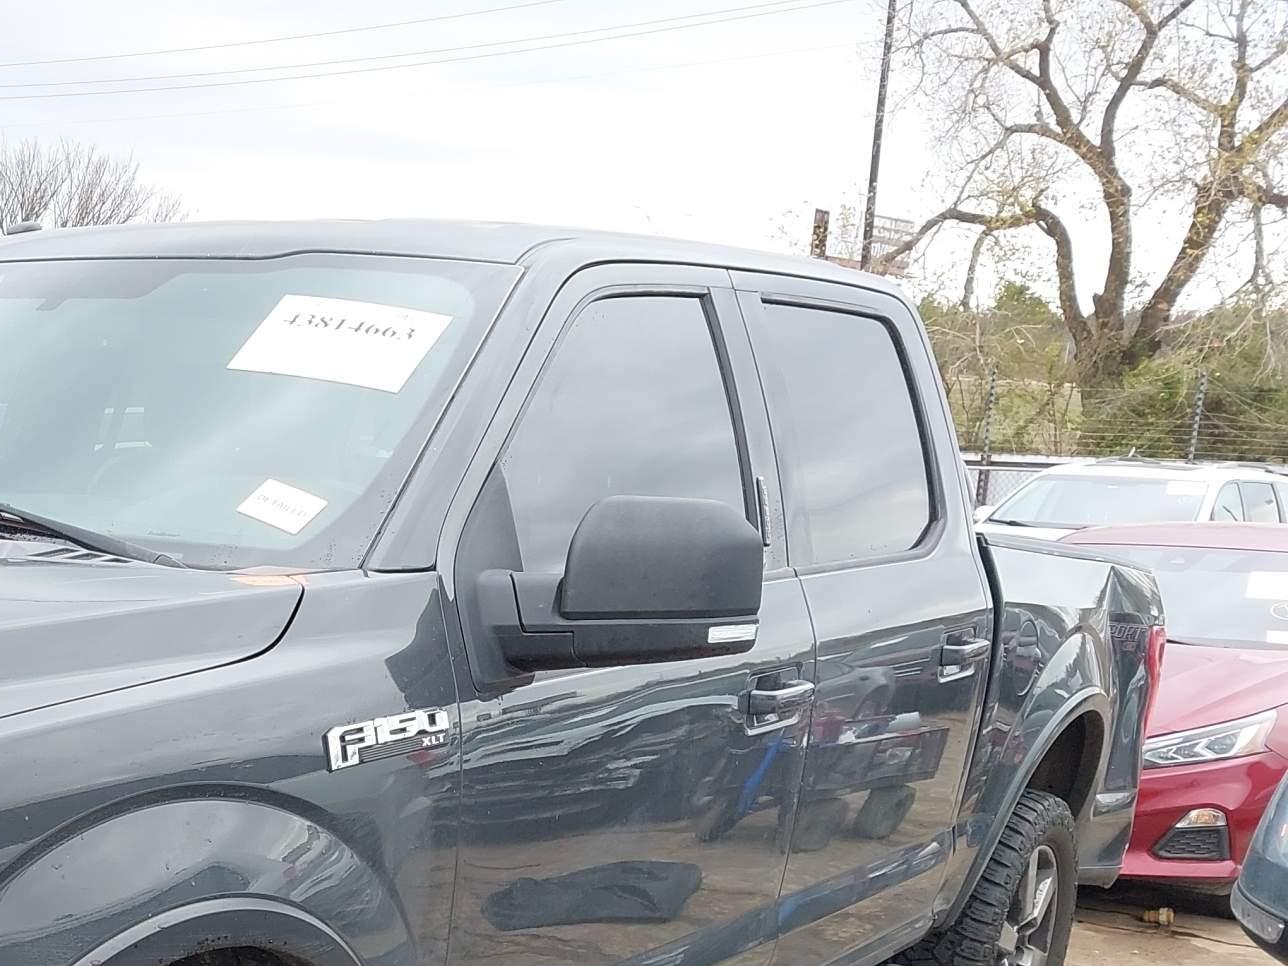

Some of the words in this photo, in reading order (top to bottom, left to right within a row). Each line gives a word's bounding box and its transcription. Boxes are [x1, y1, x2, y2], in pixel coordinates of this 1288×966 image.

[283, 312, 416, 341] 43814663
[1108, 623, 1148, 642] PORT
[421, 733, 446, 747] XLT
